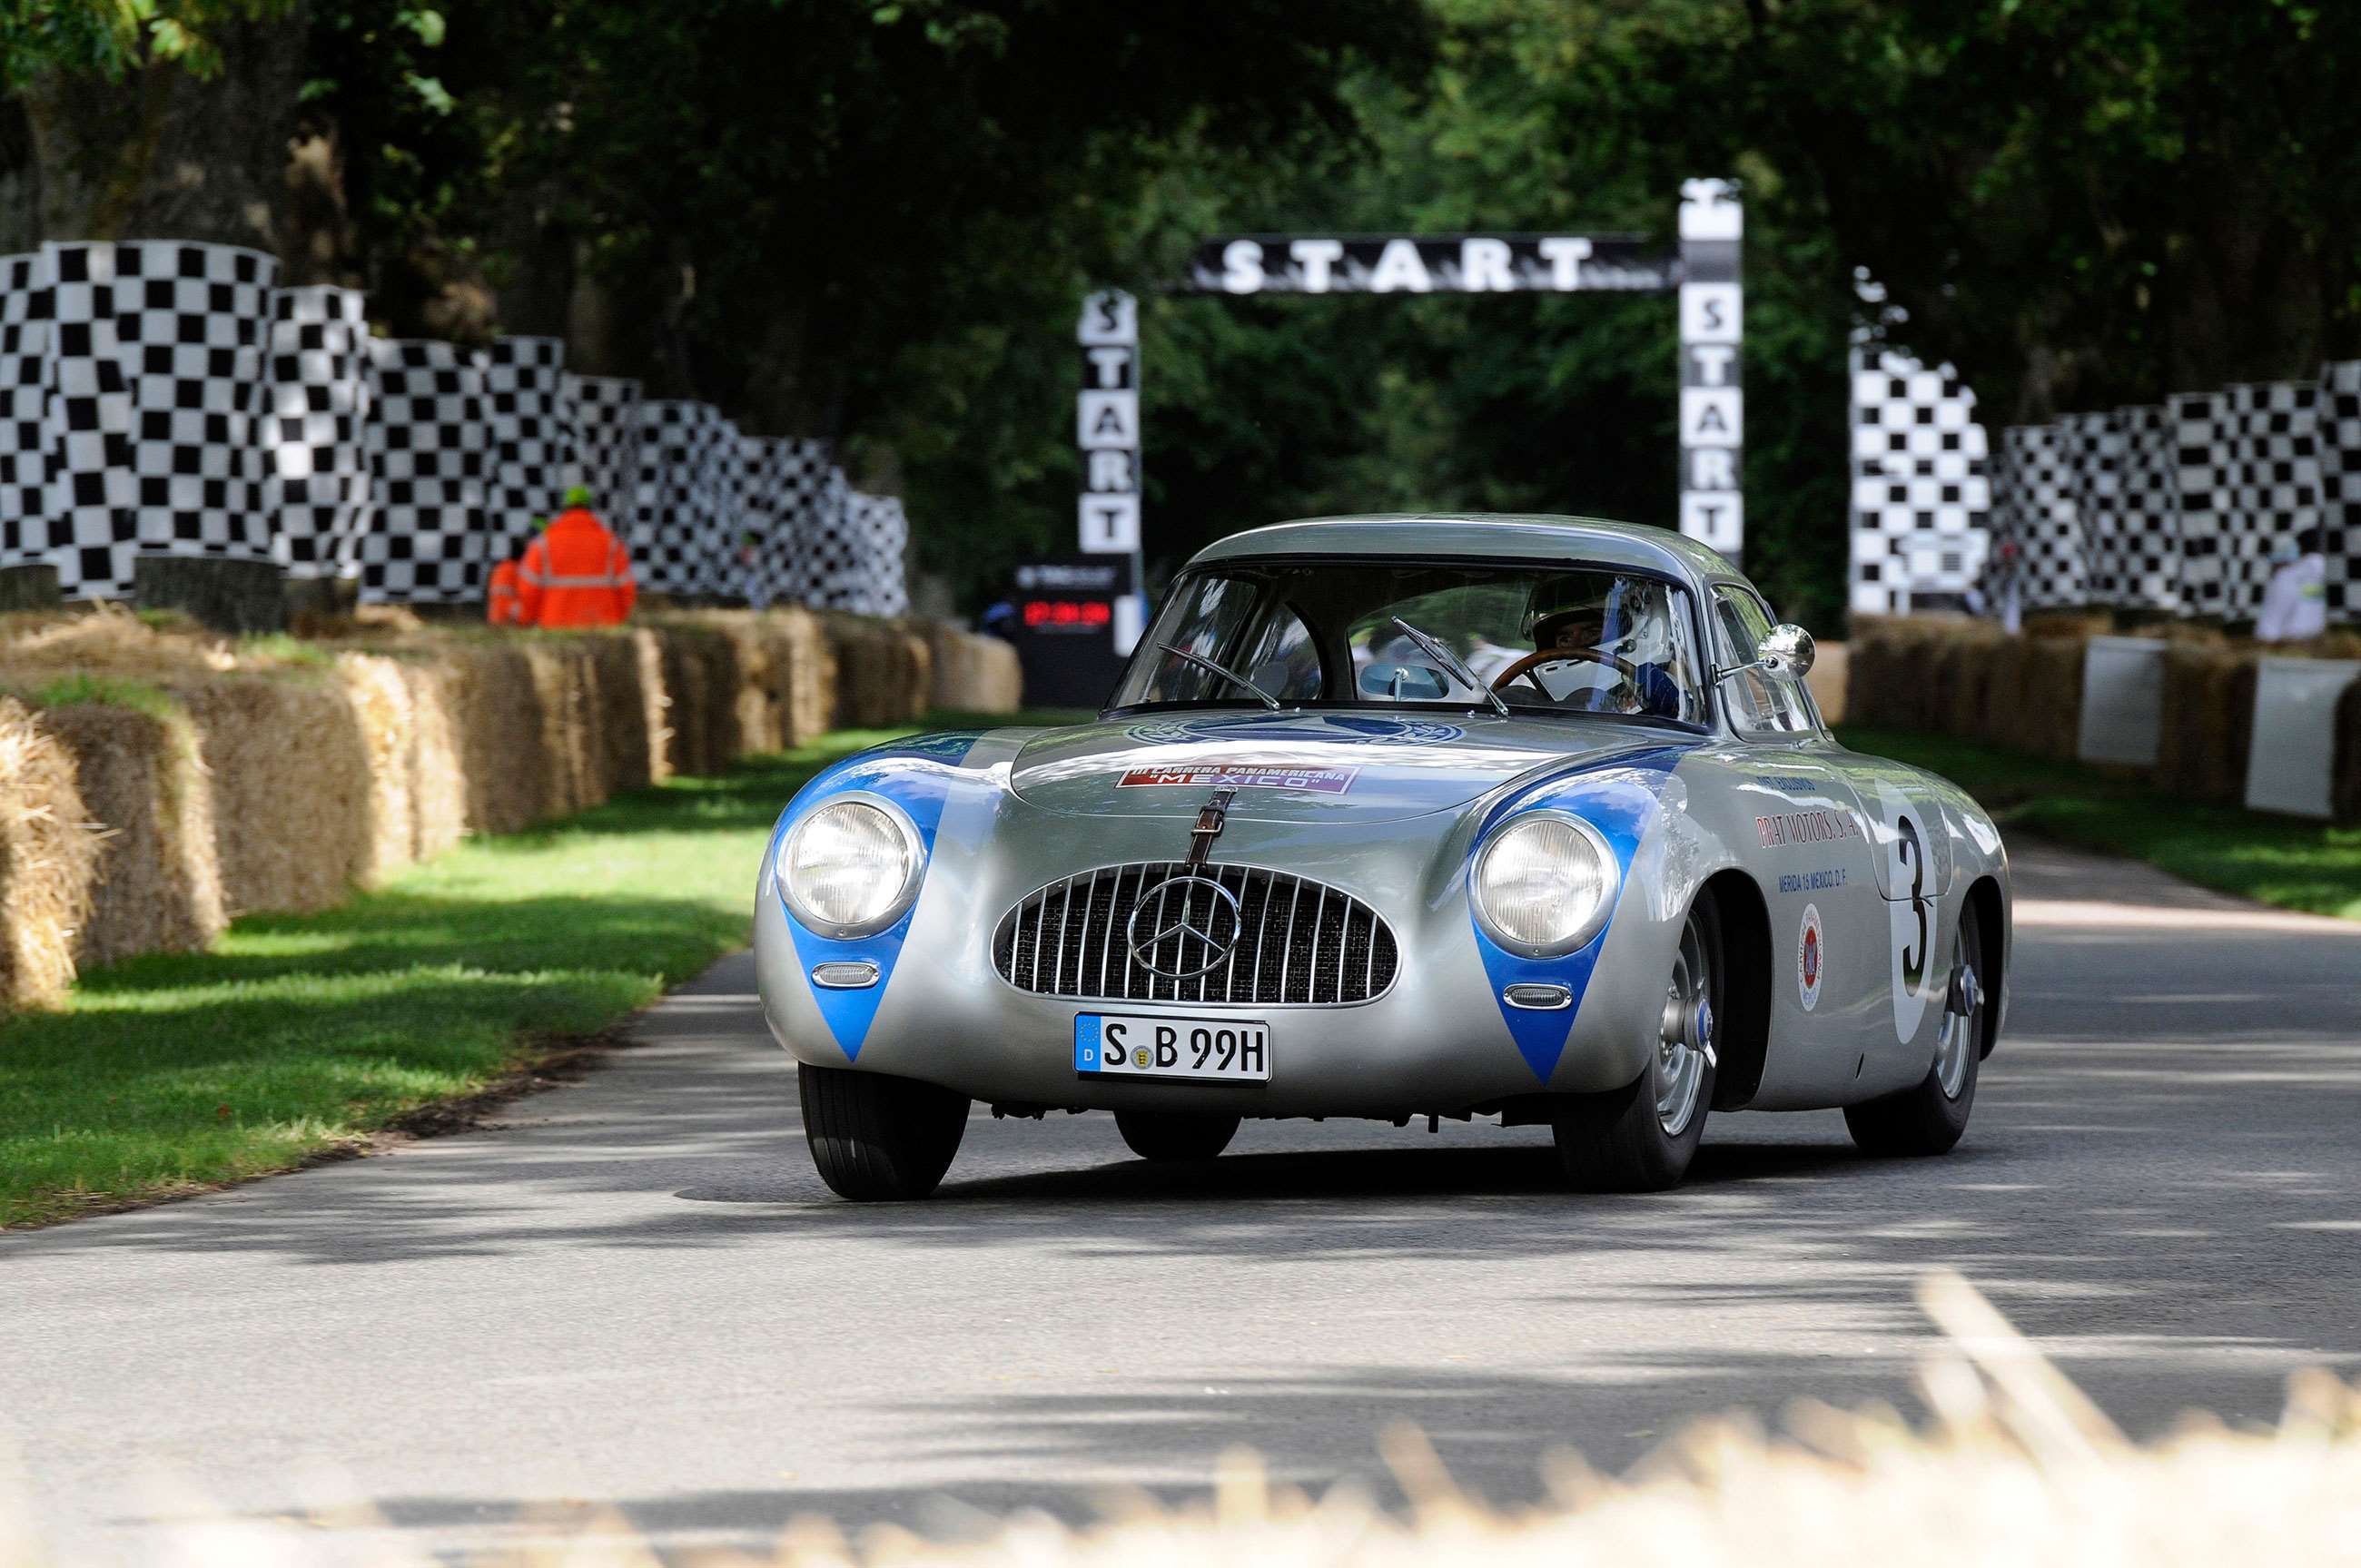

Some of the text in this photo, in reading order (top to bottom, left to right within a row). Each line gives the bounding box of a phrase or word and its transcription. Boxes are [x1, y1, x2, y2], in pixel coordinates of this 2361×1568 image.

[1222, 238, 1593, 293] START
[1088, 296, 1134, 538] START
[1692, 298, 1737, 537] START
[1147, 766, 1221, 775] CARRERA
[1225, 767, 1345, 782] PANAMERICANA
[1755, 814, 1786, 848] PRAT
[1778, 872, 1802, 893] MERIDA
[1803, 873, 1810, 891] 15
[1898, 815, 1927, 997] 3
[1084, 1049, 1094, 1061] D
[1104, 1023, 1127, 1066] S
[1156, 1026, 1178, 1068] B
[1190, 1028, 1263, 1072] 99H
